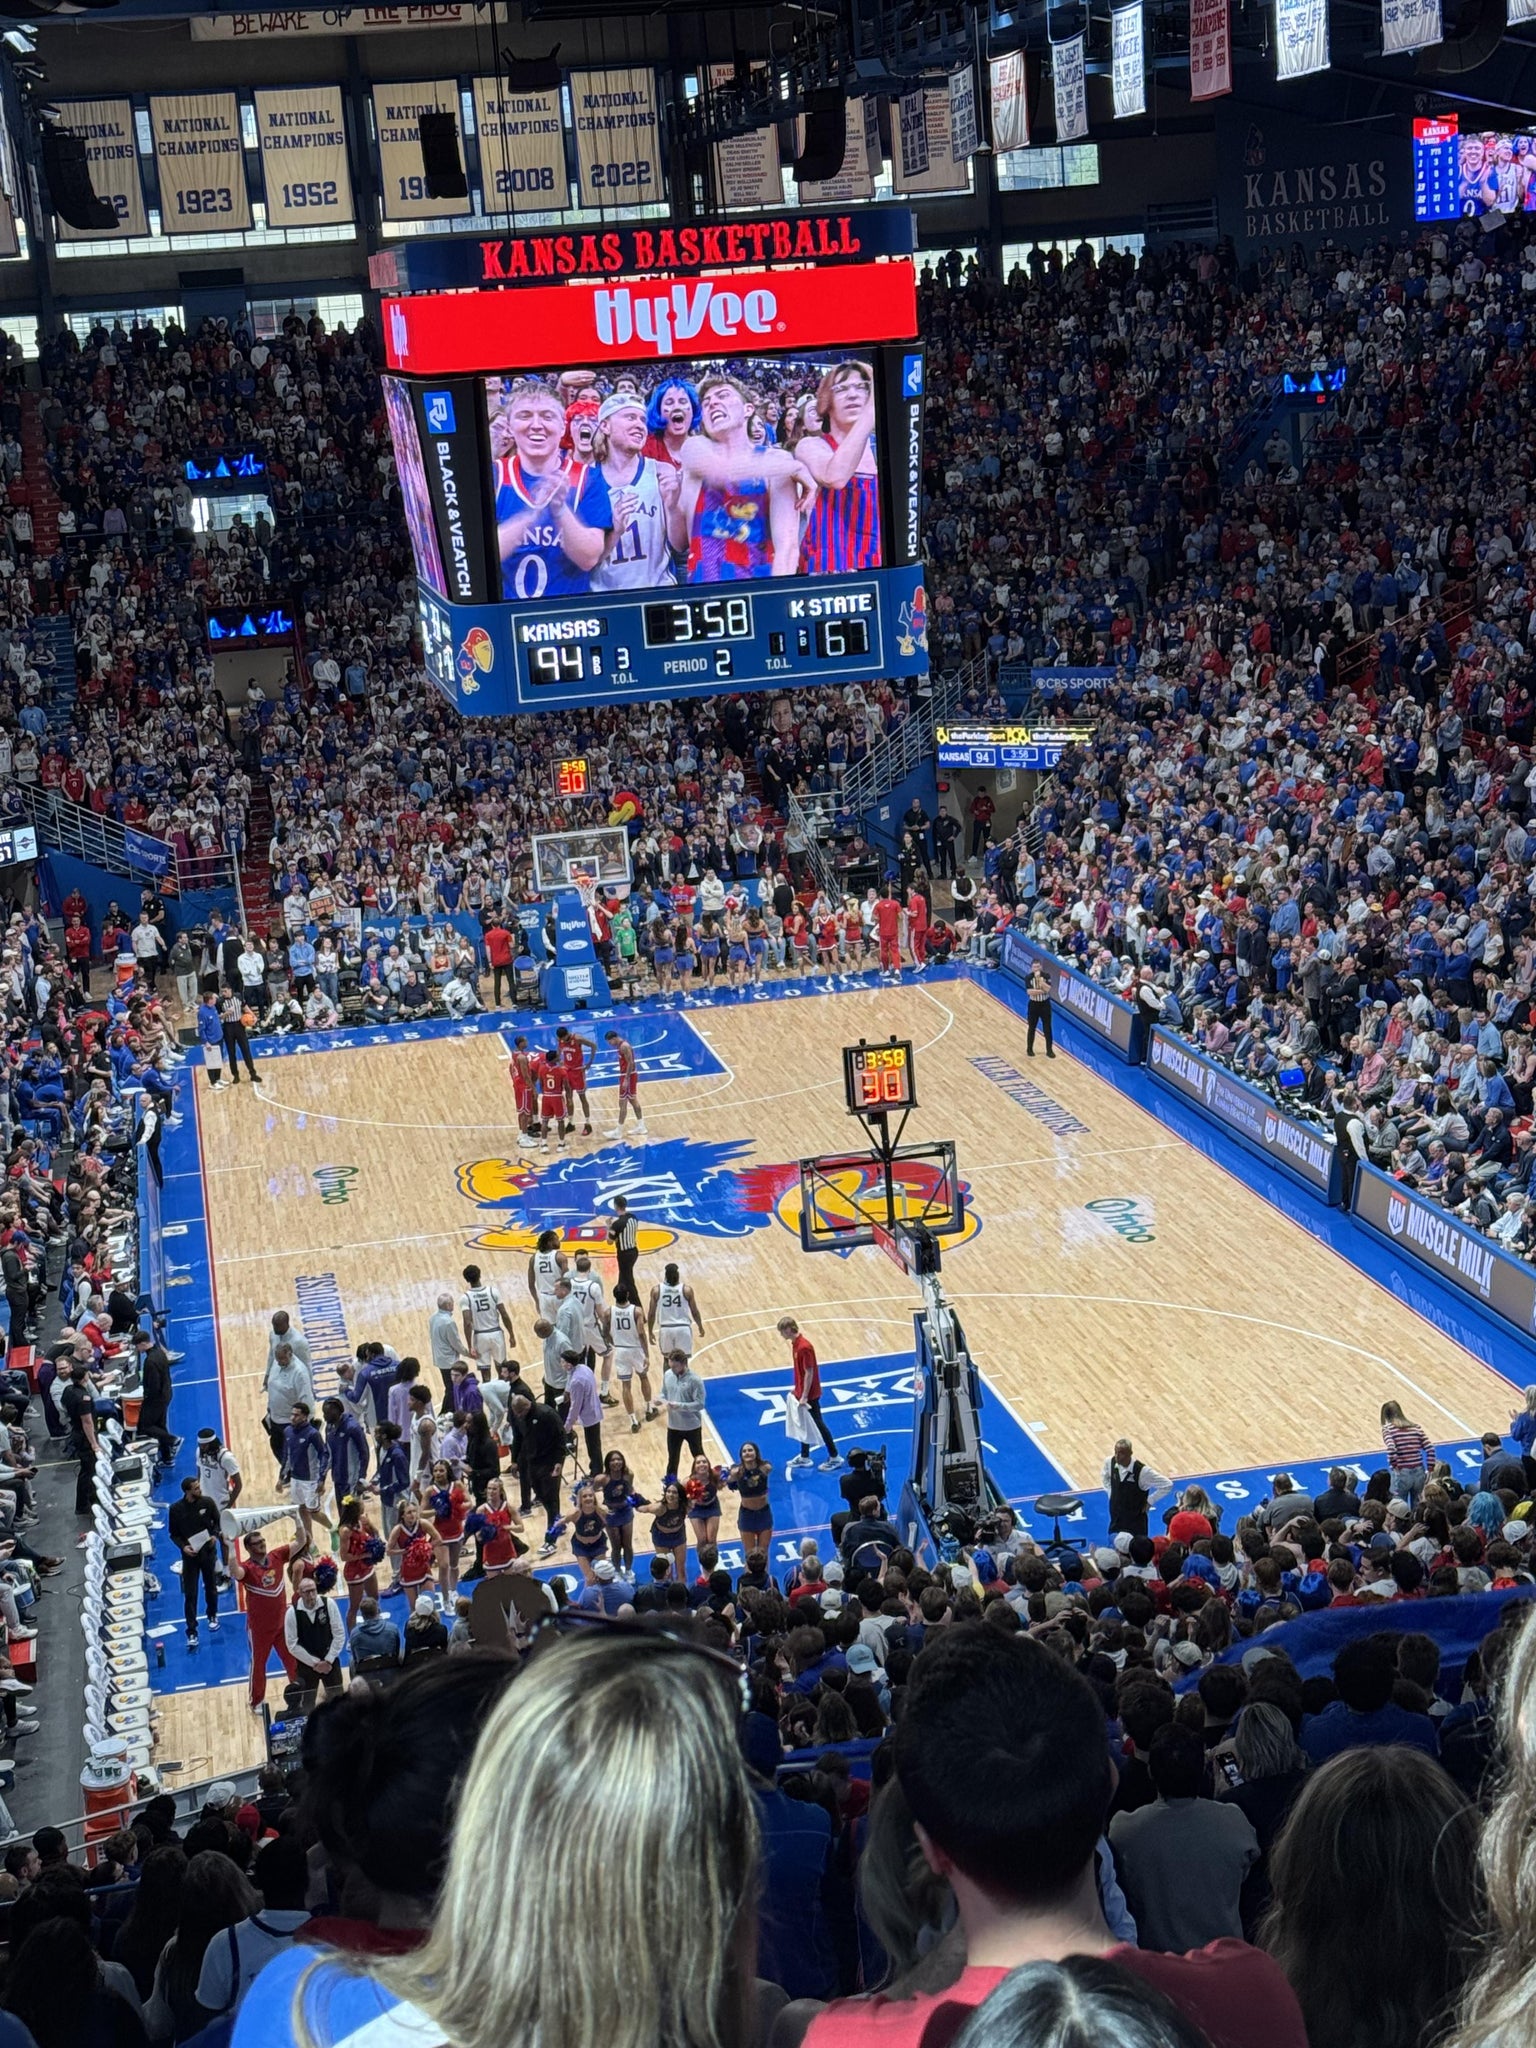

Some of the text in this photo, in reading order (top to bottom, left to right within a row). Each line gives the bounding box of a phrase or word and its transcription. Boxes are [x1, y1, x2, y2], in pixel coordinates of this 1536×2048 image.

[233, 5, 461, 35] BEWARE OF THE PHOG
[487, 98, 550, 114] NATIONAL
[584, 91, 648, 109] NATIONAL
[164, 116, 230, 134] NATIONAL
[268, 110, 334, 127] NATIONAL
[481, 119, 558, 136] CHAMPIONS
[578, 112, 655, 131] CHAMPIONS
[264, 132, 344, 150] CHAMPIONS
[381, 125, 459, 142] CHAMS
[86, 144, 134, 162] MPIONS
[158, 138, 239, 156] CHAMPIONS
[497, 168, 554, 193] 2008
[590, 161, 650, 188] 2022
[1244, 160, 1386, 209] KANSAS
[176, 188, 232, 214] 1923
[282, 181, 338, 208] 1952
[1246, 202, 1389, 238] BASKETBALL
[480, 216, 861, 280] KANSAS BASKETBALL
[908, 404, 920, 558] BLACK & VEATCH
[436, 442, 472, 597] BLACK & VEATCH
[515, 554, 548, 599] 0
[790, 593, 872, 618] K STATE
[522, 618, 600, 642] KANSAS
[672, 598, 748, 641] 3:58
[825, 618, 868, 656] 67
[537, 646, 584, 682] 94
[617, 648, 630, 670] 3
[664, 658, 708, 674] PERIOD
[716, 649, 730, 676] 2
[766, 658, 792, 670] T.O.L.
[610, 674, 638, 686] T.O.L.
[1046, 677, 1114, 690] CBS SPORTS
[562, 760, 586, 773] 3:58
[939, 751, 970, 762] KANSAS
[976, 752, 989, 763] 94
[559, 772, 585, 794] 30
[1068, 976, 1114, 1030] MUSCLE MILK
[258, 1032, 421, 1056] JAMES
[866, 1049, 905, 1070] 3:58
[1161, 1042, 1205, 1090] MUSCLE MILK
[546, 1078, 554, 1089] 0
[862, 1070, 902, 1104] 30
[1276, 1119, 1330, 1176] MUSCLE MILK
[1406, 1202, 1494, 1294] MUSCLE MILK
[539, 1260, 553, 1274] 21
[475, 1300, 490, 1312] 15
[662, 1295, 682, 1308] 34
[616, 1318, 630, 1330] 10
[204, 1468, 211, 1478] 3
